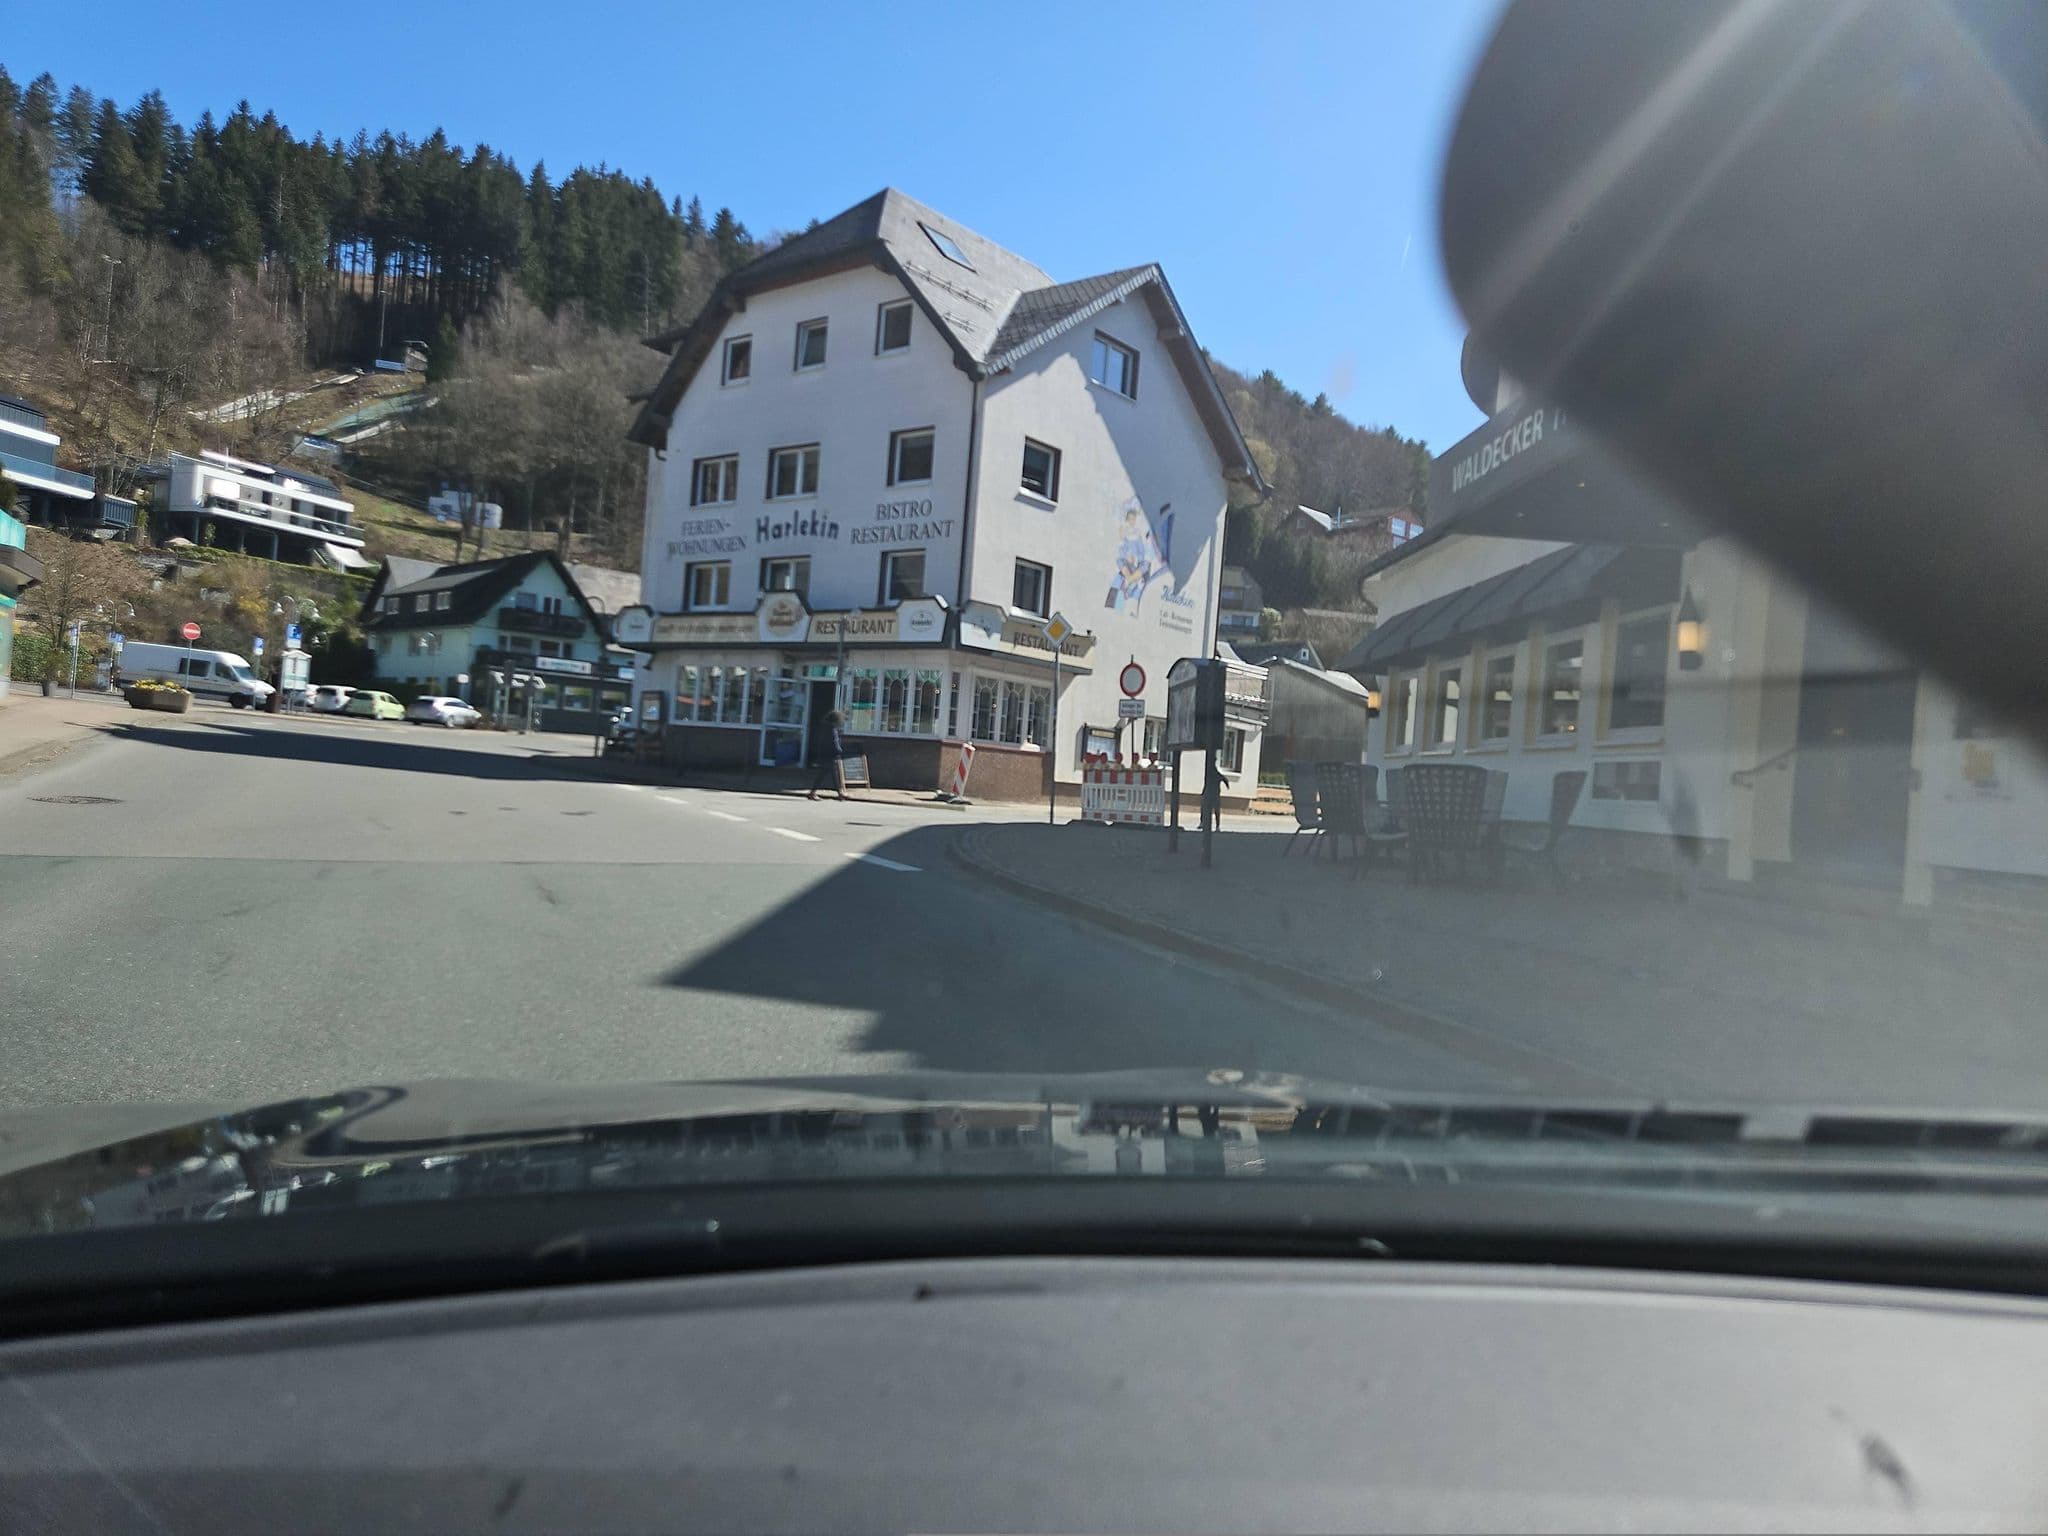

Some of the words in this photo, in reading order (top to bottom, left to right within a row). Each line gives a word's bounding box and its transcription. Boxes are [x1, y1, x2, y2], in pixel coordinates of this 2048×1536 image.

[1452, 408, 1544, 493] WALDECKER
[876, 499, 933, 521] BISTRO
[681, 519, 732, 537] FERIEN-
[756, 509, 840, 543] Harlekin
[851, 519, 955, 545] RESTAURANT
[667, 535, 747, 556] WOHNUNGEN
[815, 618, 896, 635] RESTAURANT
[1014, 631, 1080, 656] RESTAUANT
